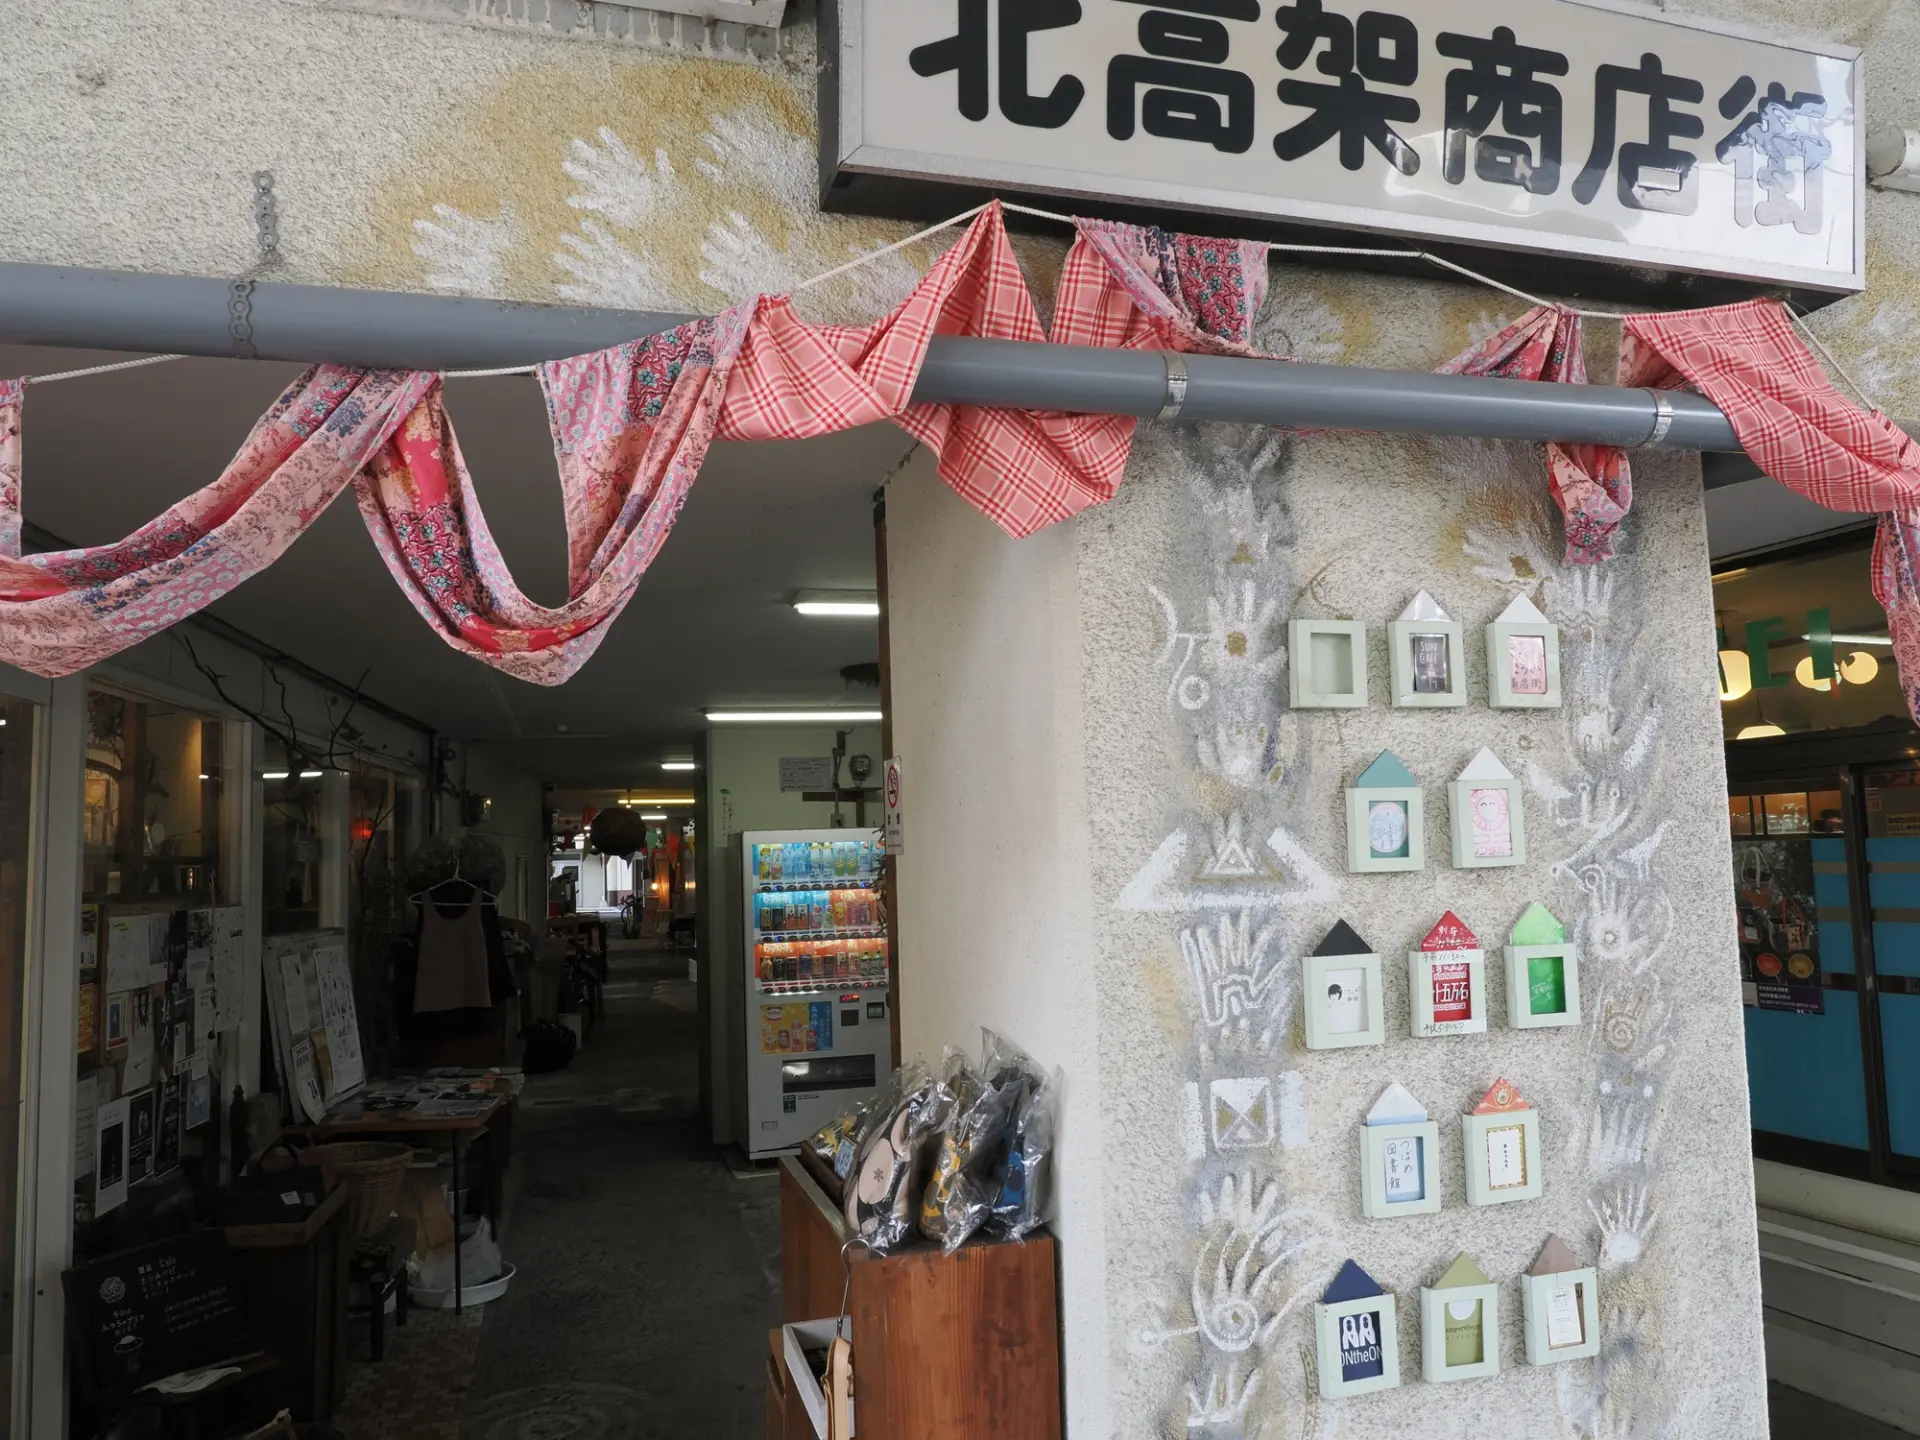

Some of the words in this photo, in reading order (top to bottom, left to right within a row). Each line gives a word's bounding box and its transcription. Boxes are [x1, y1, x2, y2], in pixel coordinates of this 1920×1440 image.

[908, 0, 1832, 235] 北高架商店街
[1387, 1142, 1401, 1190] 図書館
[1400, 1140, 1413, 1173] つばめ
